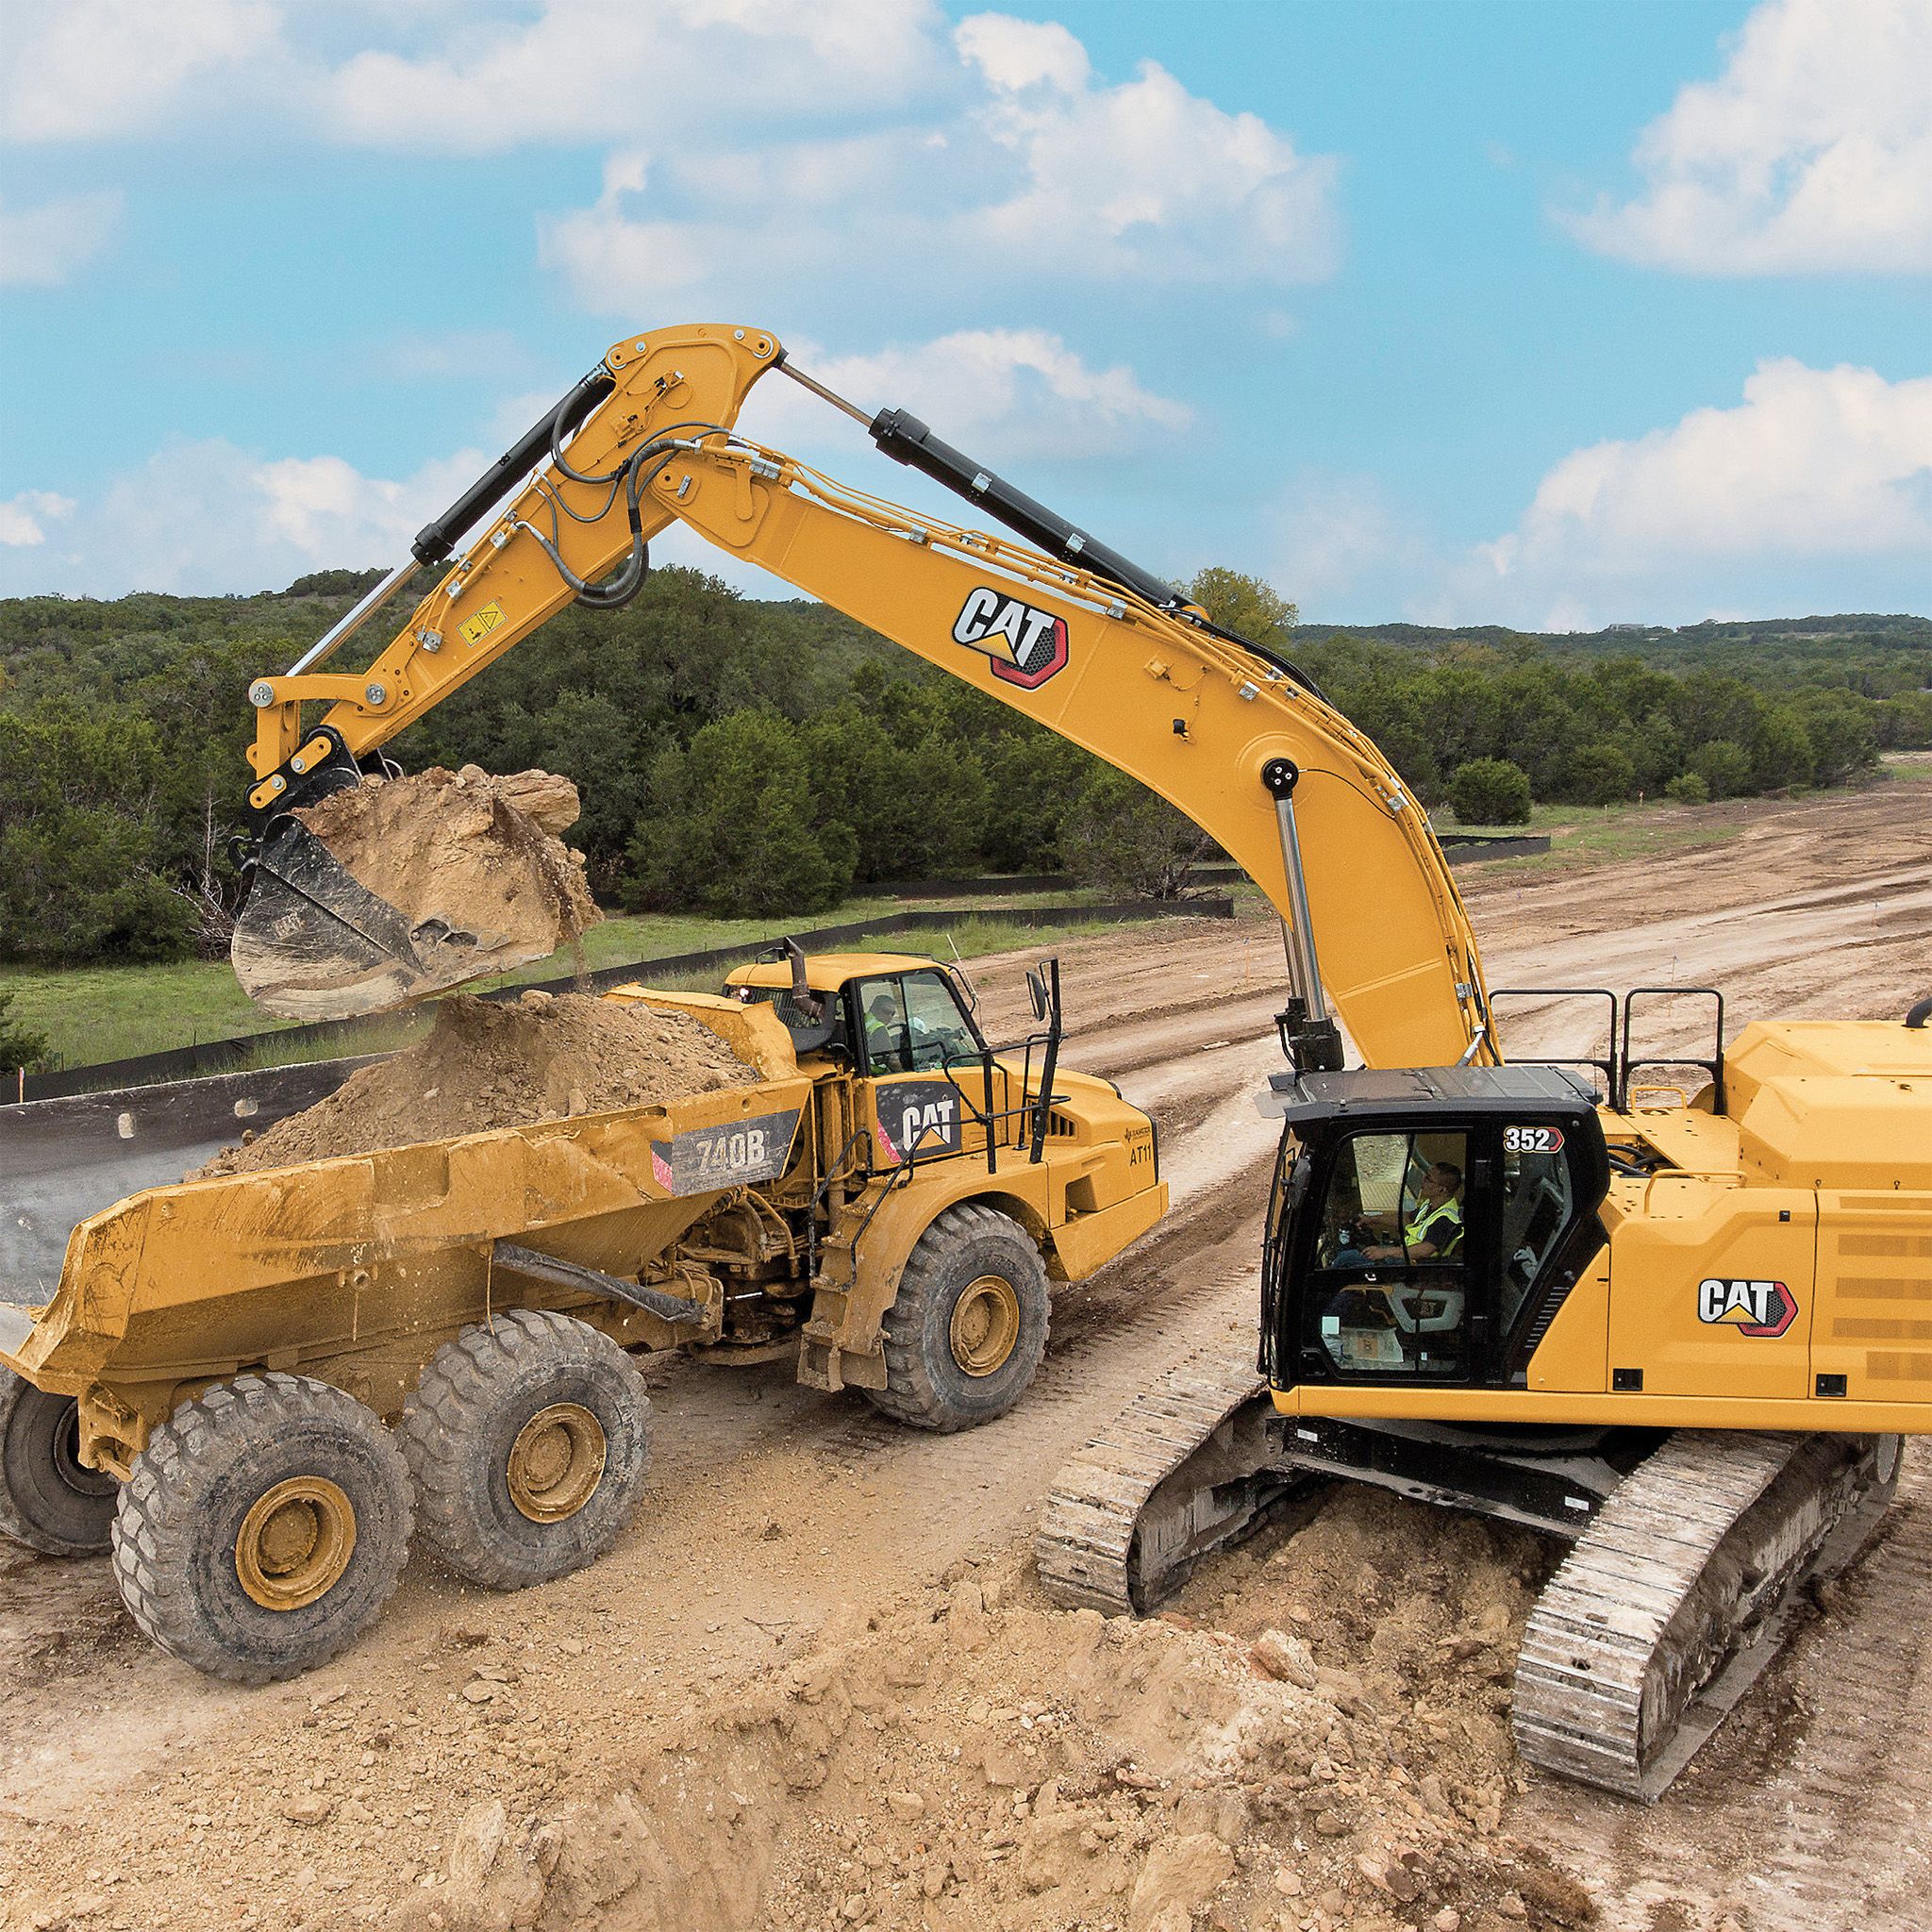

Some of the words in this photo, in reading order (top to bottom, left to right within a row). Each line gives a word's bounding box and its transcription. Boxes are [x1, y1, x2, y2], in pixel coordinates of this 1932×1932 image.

[954, 588, 1056, 667] CAT
[903, 1099, 954, 1152] CAT
[1506, 1127, 1550, 1150] 352
[696, 1129, 765, 1175] 740B
[1130, 1142, 1151, 1167] AT11
[1699, 1279, 1774, 1324] CAT
